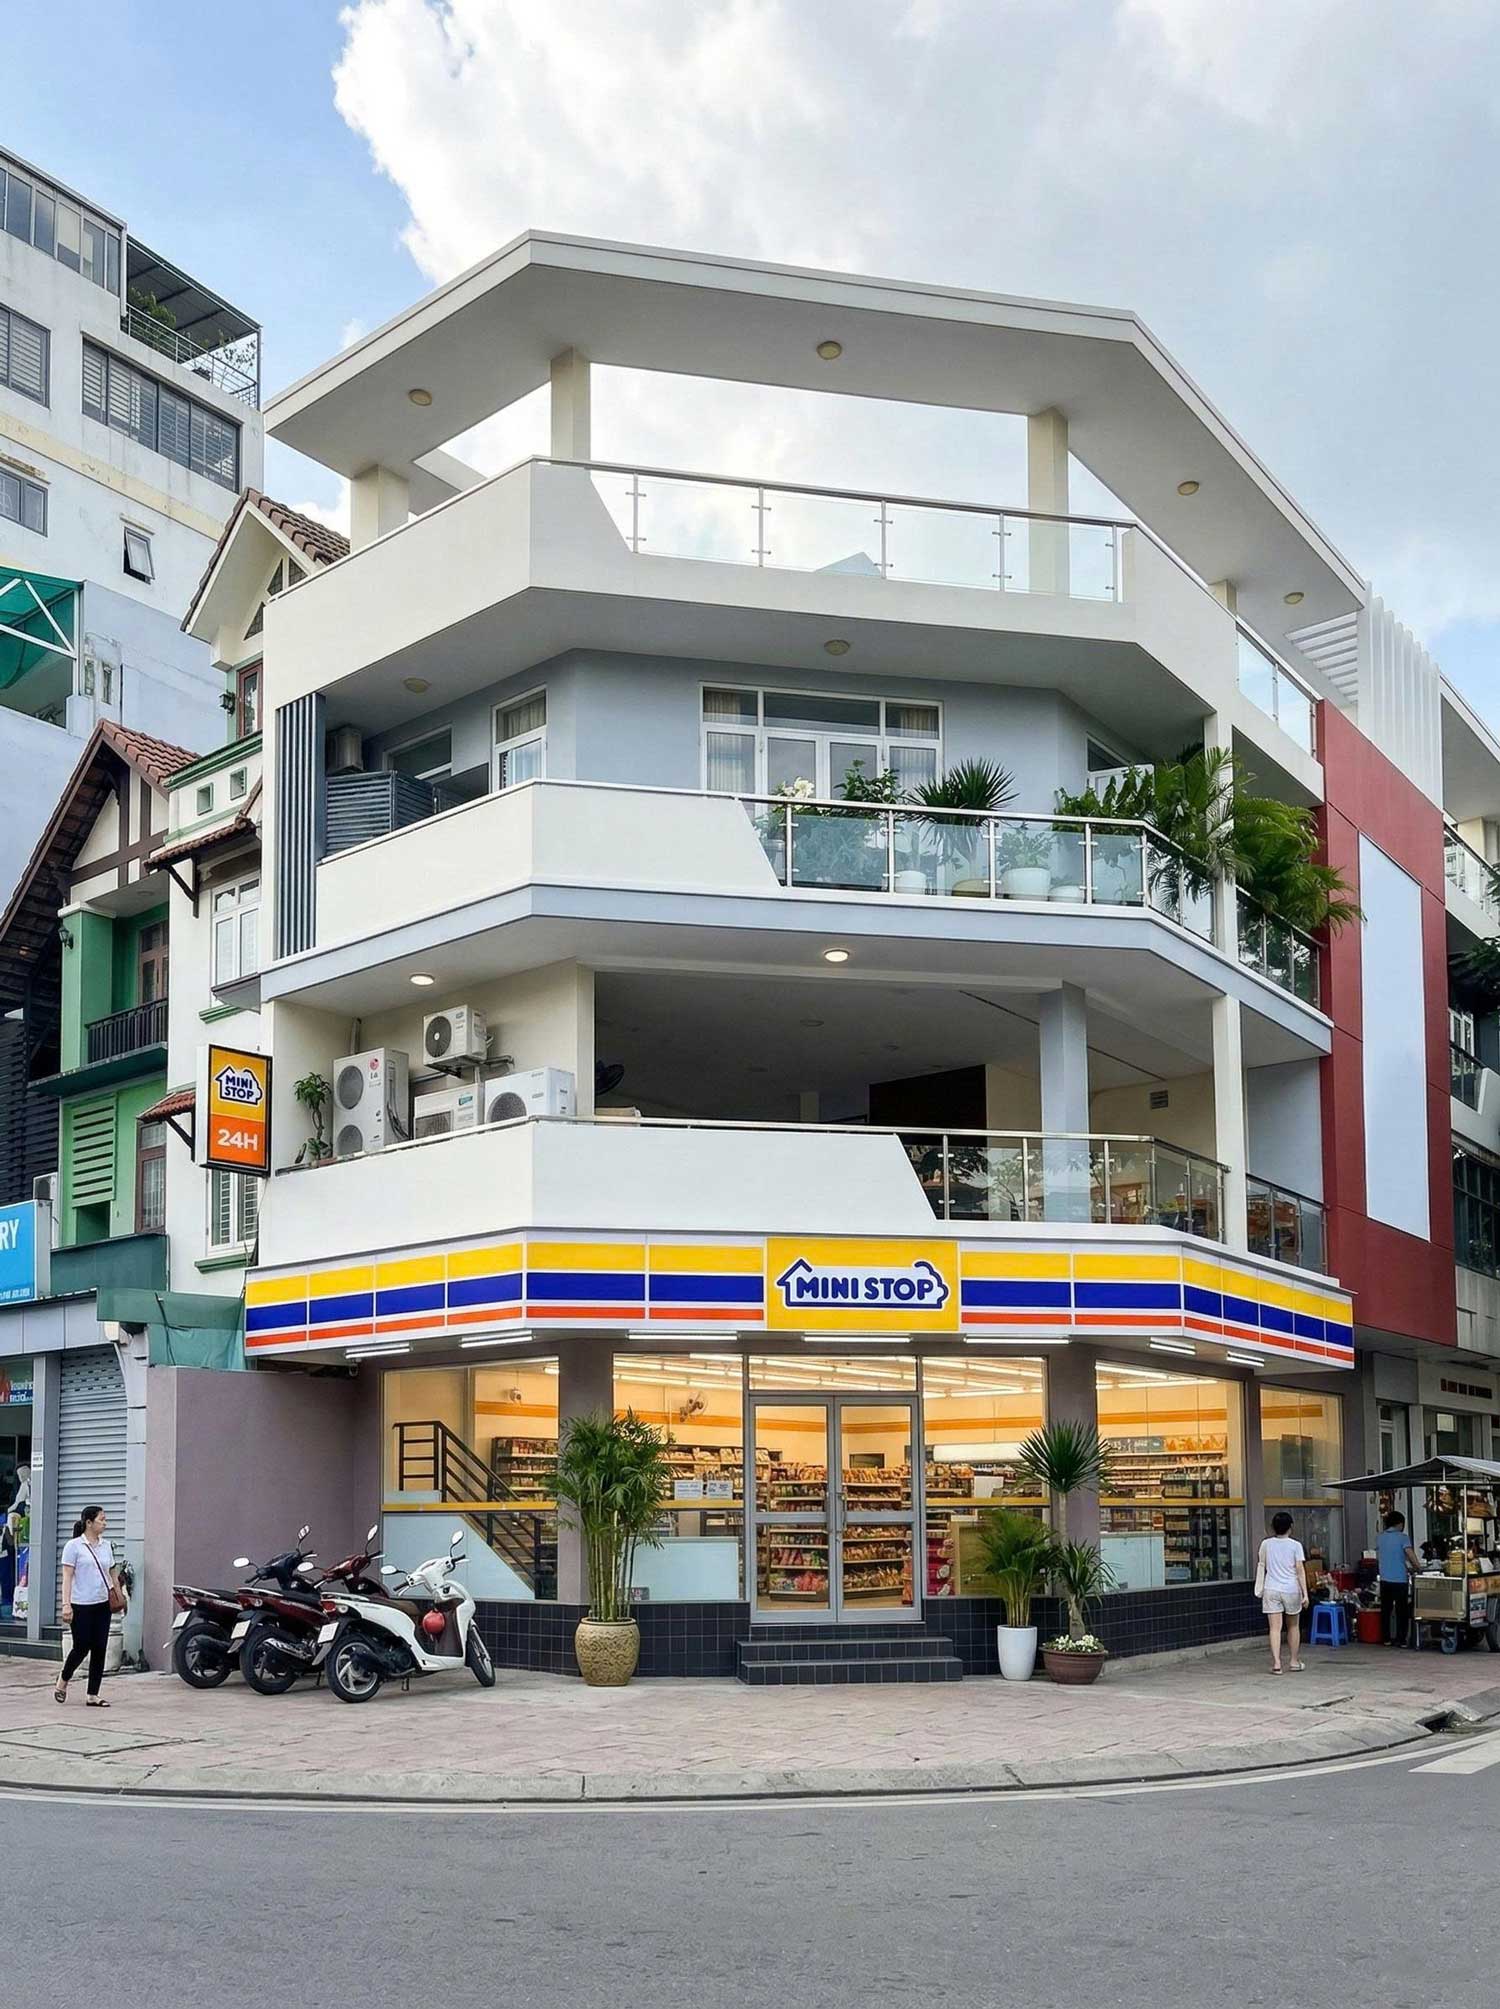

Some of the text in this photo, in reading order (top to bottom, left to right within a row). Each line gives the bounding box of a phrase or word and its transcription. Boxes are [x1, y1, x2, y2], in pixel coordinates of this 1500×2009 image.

[225, 1074, 253, 1089] MINI
[224, 1086, 254, 1100] STOP
[217, 1128, 258, 1152] 24H
[796, 1276, 934, 1301] MINI STOP
